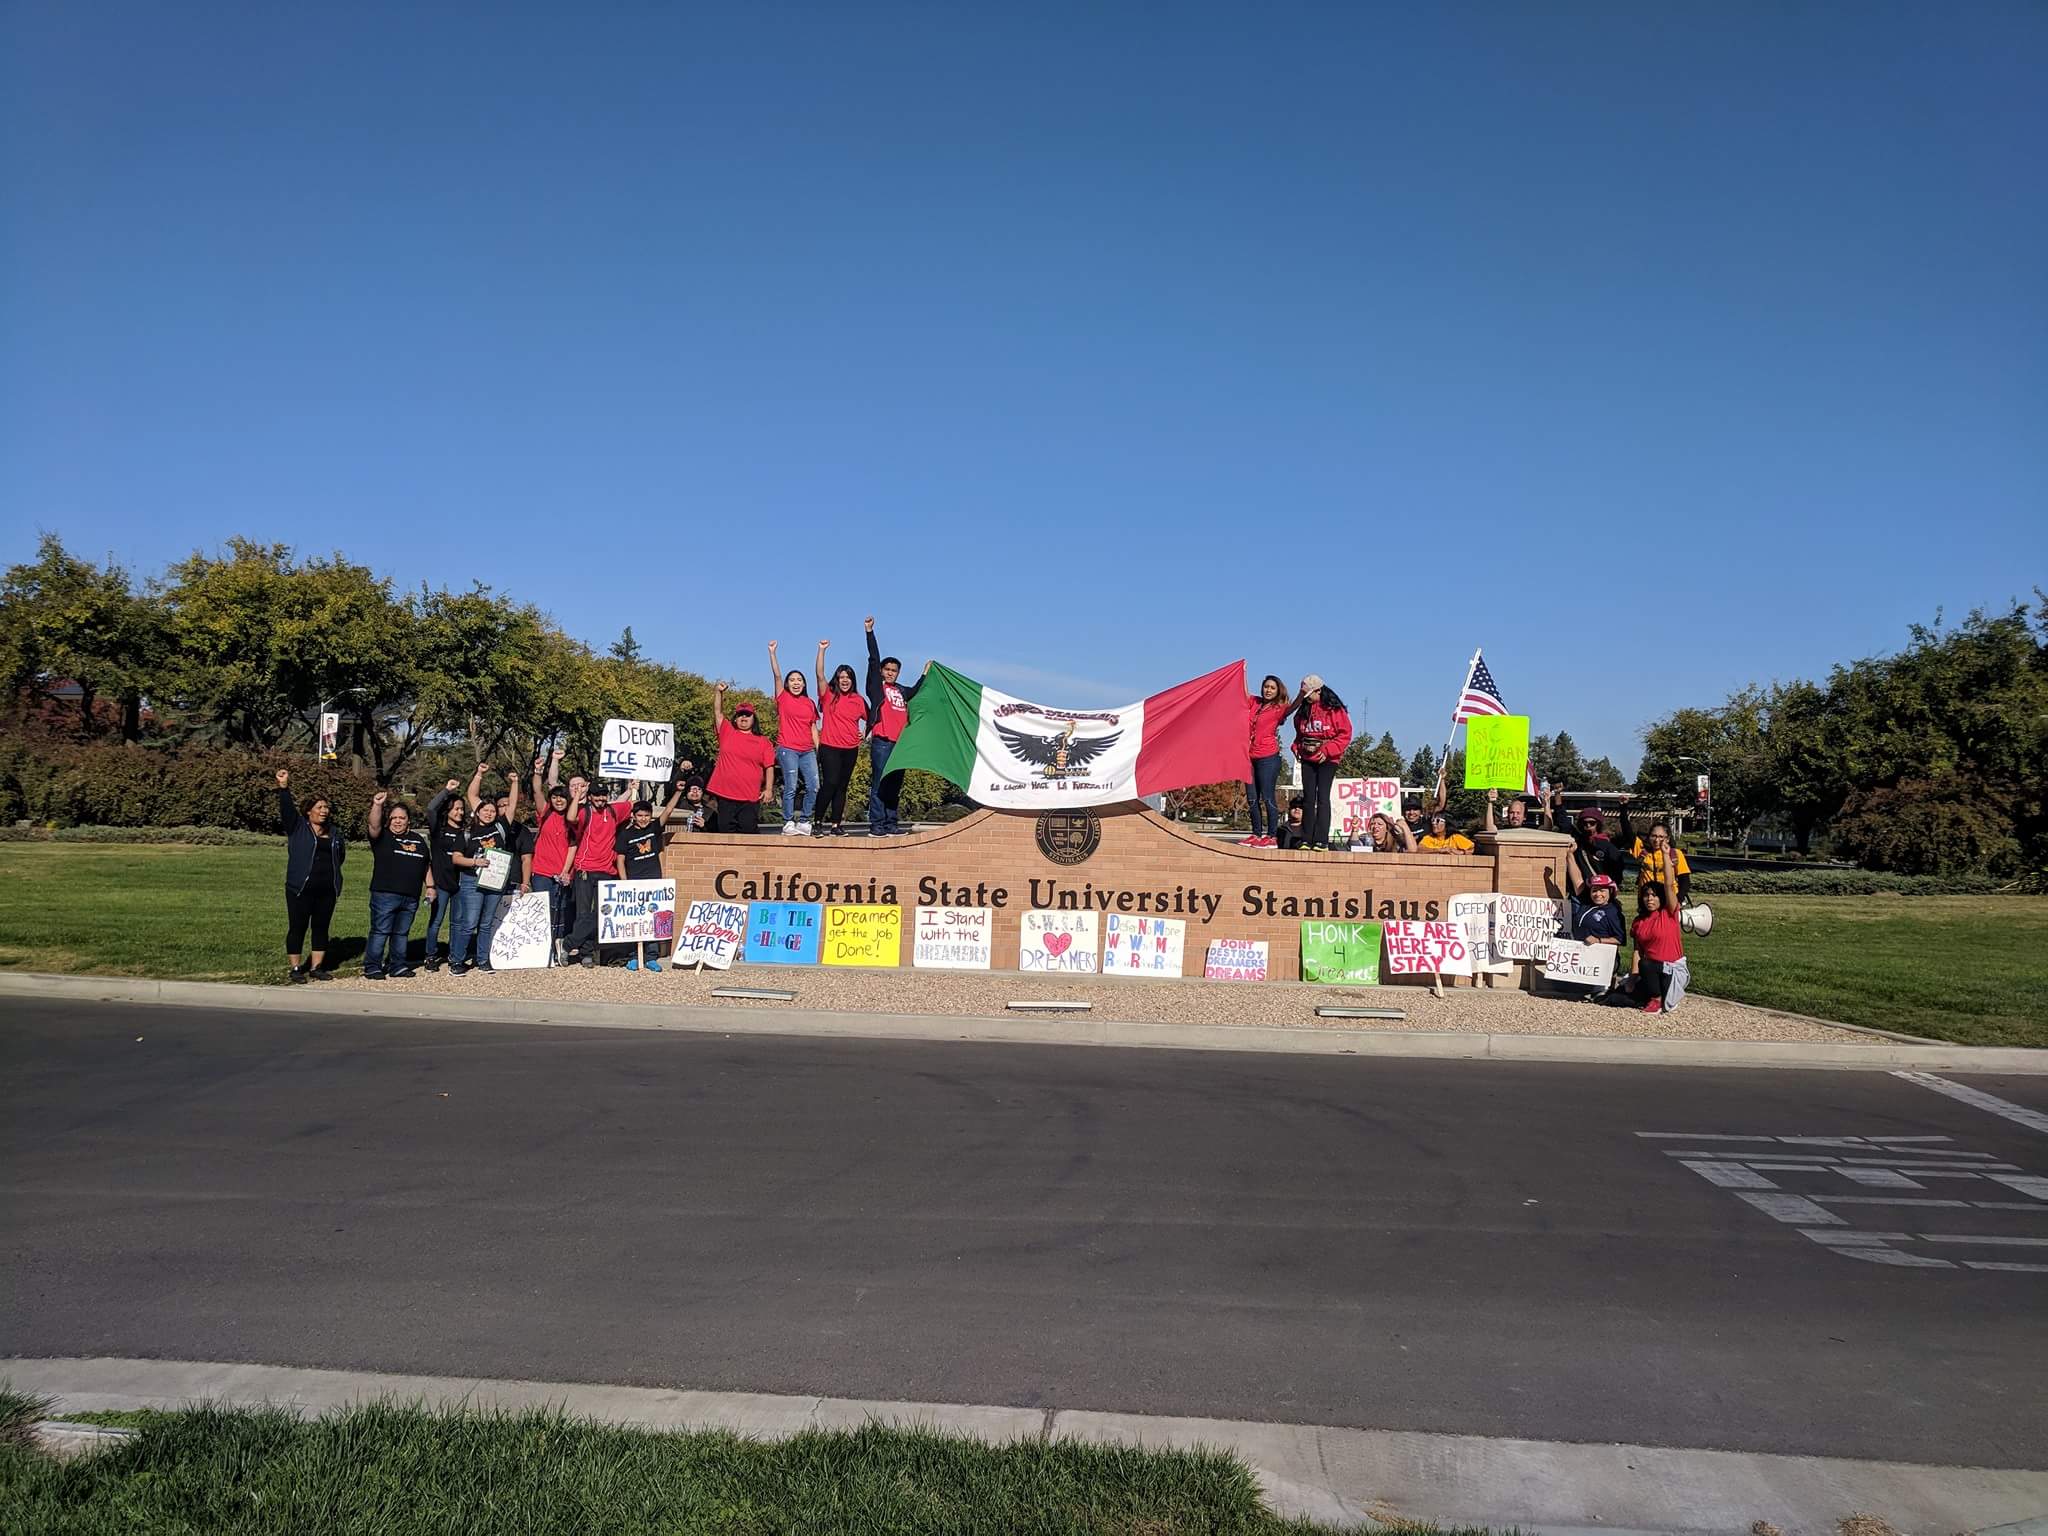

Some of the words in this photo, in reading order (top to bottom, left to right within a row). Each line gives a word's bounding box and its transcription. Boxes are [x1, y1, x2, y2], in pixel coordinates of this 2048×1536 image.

[619, 725, 669, 746] DEPORT
[601, 750, 638, 765] ICE
[1338, 781, 1398, 799] DEFEND
[1346, 801, 1380, 817] THE
[1048, 852, 1088, 864] STANISLAUS
[604, 884, 675, 906] Immigrants
[715, 870, 898, 905] California
[919, 876, 1008, 907] State
[1029, 879, 1222, 924] University
[1242, 885, 1439, 921] Stanislaus
[614, 904, 646, 917] Make
[689, 903, 747, 933] DREAMERS
[788, 910, 813, 927] THE
[832, 909, 898, 926] Dreamers
[920, 911, 938, 925] I
[944, 911, 985, 926] Stand
[1507, 914, 1564, 930] RECIPIENTS
[827, 928, 847, 942] get
[851, 928, 867, 938] the
[920, 927, 950, 941] with
[954, 929, 979, 942] the
[1308, 924, 1367, 944] HONK
[1385, 922, 1415, 936] WE
[1423, 922, 1459, 940] ARE
[679, 936, 730, 956] HERE
[837, 941, 879, 958] Done!
[1221, 940, 1254, 949] DONT
[1387, 937, 1432, 955] HERE
[1435, 940, 1466, 960] TO
[1498, 940, 1508, 956] OF
[1512, 941, 1528, 957] OUR
[915, 944, 988, 963] DREAMERS
[1021, 949, 1097, 972] DREAMERS
[1207, 957, 1265, 967] DREAMERS
[1210, 948, 1263, 959] DESTROY
[1334, 945, 1346, 964] 4
[1548, 951, 1579, 965] RISE
[1391, 956, 1443, 973] STAY
[1205, 966, 1266, 981] DREAMS
